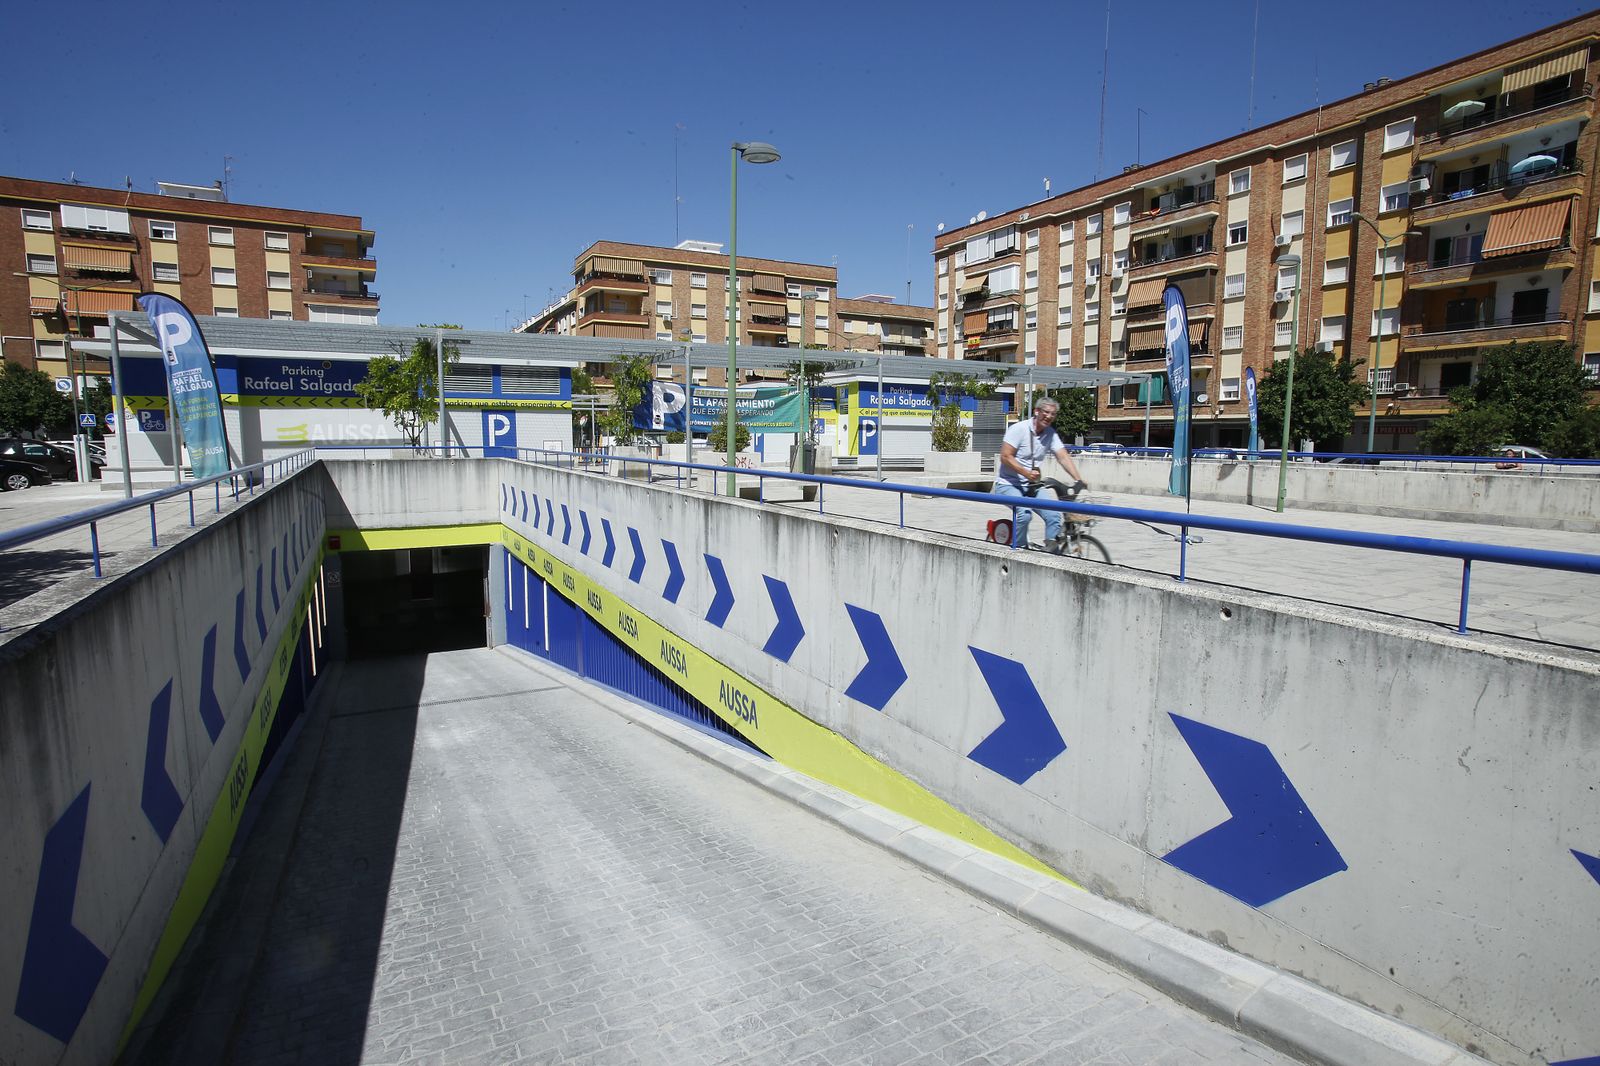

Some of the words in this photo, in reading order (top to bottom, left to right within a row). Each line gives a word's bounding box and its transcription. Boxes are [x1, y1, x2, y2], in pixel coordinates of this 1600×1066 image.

[154, 312, 192, 366] P
[173, 374, 205, 388] RAFAEL
[282, 366, 324, 378] Parking
[175, 380, 213, 395] SALGADO
[244, 377, 294, 391] Rafael
[889, 387, 913, 397] Parking
[652, 381, 686, 430] P
[692, 397, 705, 406] EL
[692, 407, 706, 415] QUE
[898, 395, 932, 408] Salgado
[141, 412, 152, 423] P
[310, 423, 391, 445] AUSSA
[488, 413, 511, 447] P
[862, 419, 877, 447] P
[562, 571, 576, 594] AUSSA
[587, 589, 603, 614] AUSSA
[618, 610, 639, 641] AUSSA
[660, 639, 688, 679] AUSSA
[719, 679, 758, 730] AUSSA
[230, 748, 248, 822] AUSSA
